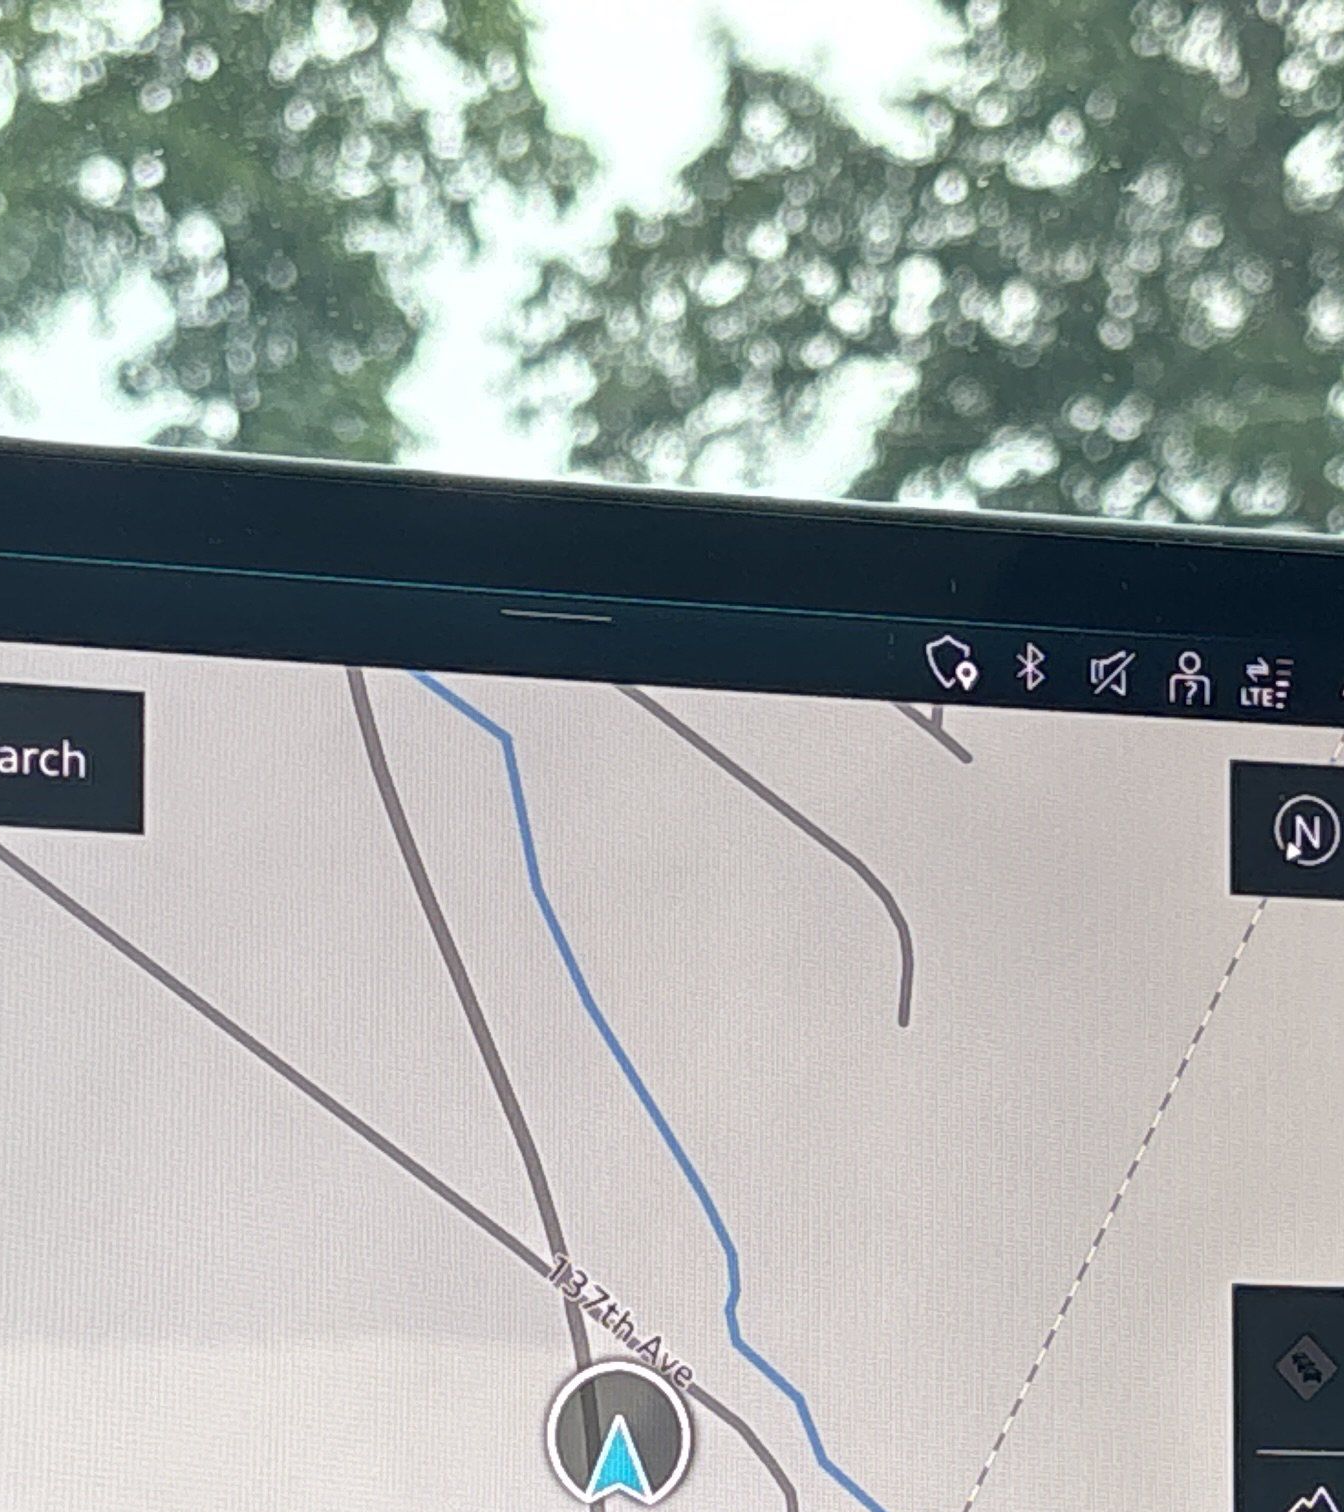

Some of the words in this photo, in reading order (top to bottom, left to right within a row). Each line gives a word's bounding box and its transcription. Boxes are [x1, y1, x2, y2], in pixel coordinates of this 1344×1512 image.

[1240, 685, 1274, 709] LTE
[1293, 814, 1321, 850] N
[549, 1254, 636, 1343] 137th
[636, 1335, 694, 1389] Ave
